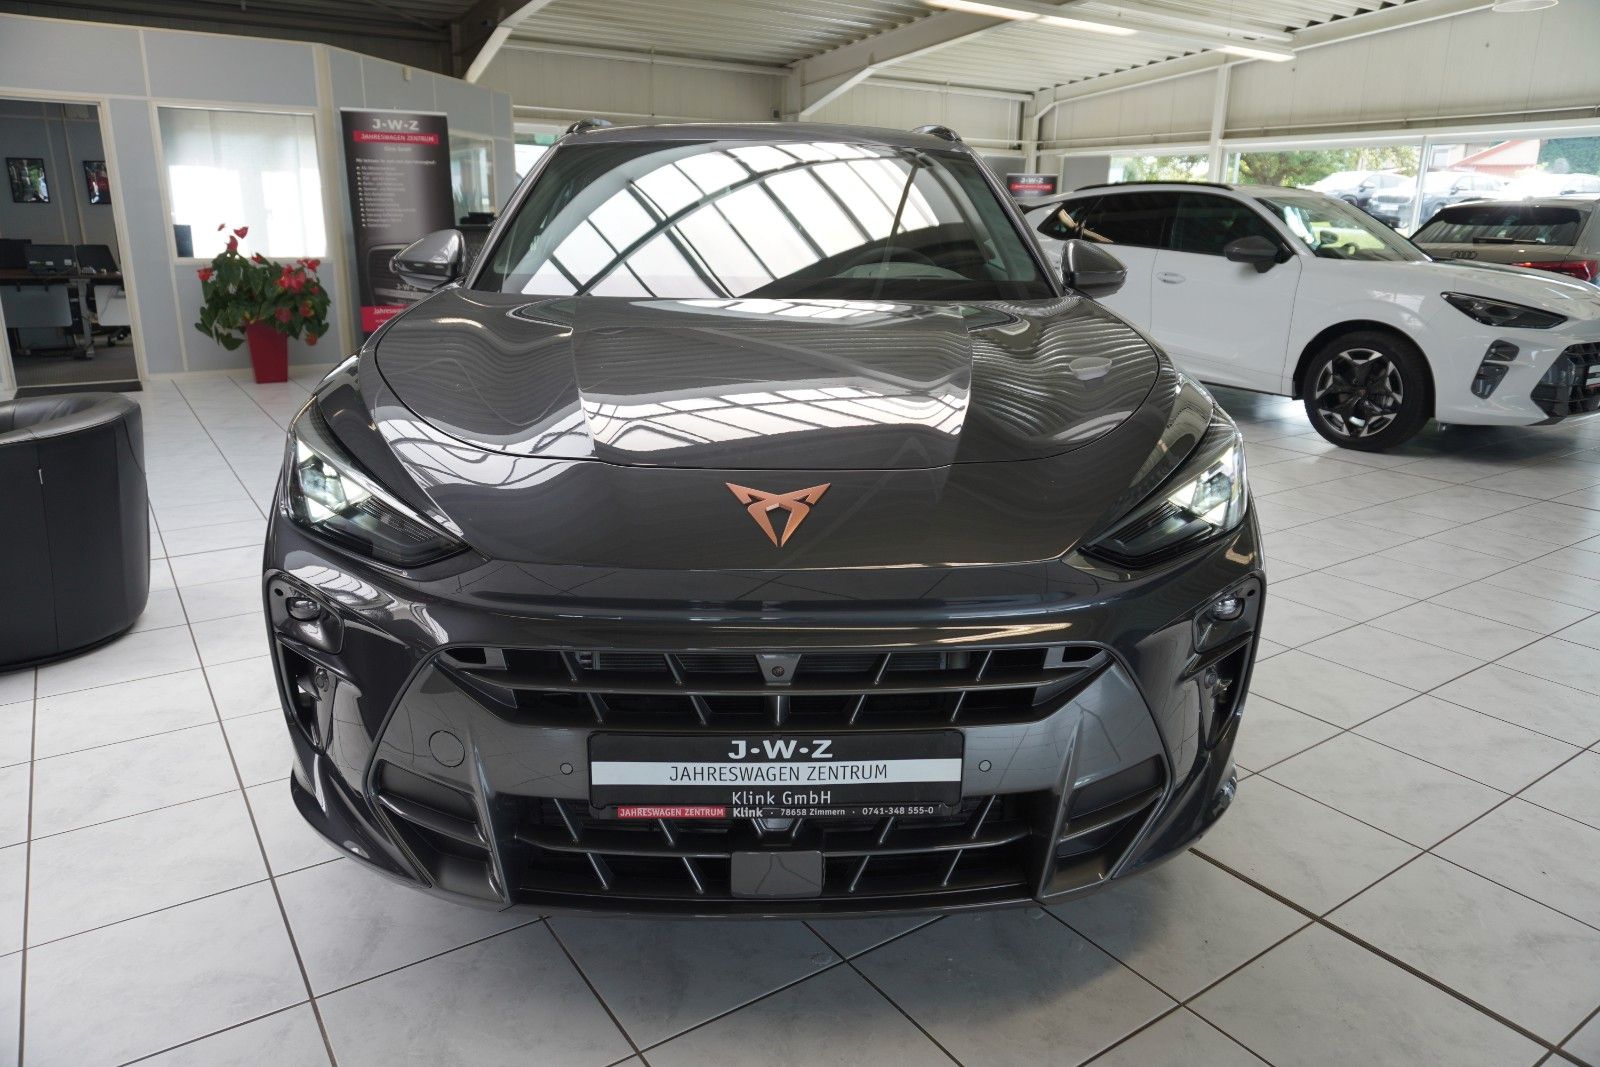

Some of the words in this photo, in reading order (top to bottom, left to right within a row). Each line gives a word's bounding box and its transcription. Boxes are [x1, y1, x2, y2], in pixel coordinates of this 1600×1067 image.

[361, 133, 406, 141] JAHRESWAGEN
[407, 134, 434, 142] ZENTRUM
[669, 766, 800, 782] JAHRESWAGEN
[806, 764, 887, 781] ZENTRUM
[732, 791, 775, 805] Klink
[782, 790, 831, 805] GmbH
[620, 808, 682, 817] JAHRESWAGEN
[684, 808, 724, 817] ZENTRUM
[733, 807, 763, 818] Klink
[781, 808, 807, 816] 78658
[809, 807, 846, 816] Zimmern
[862, 807, 905, 815] 0741-348
[908, 806, 934, 815] 555-0
